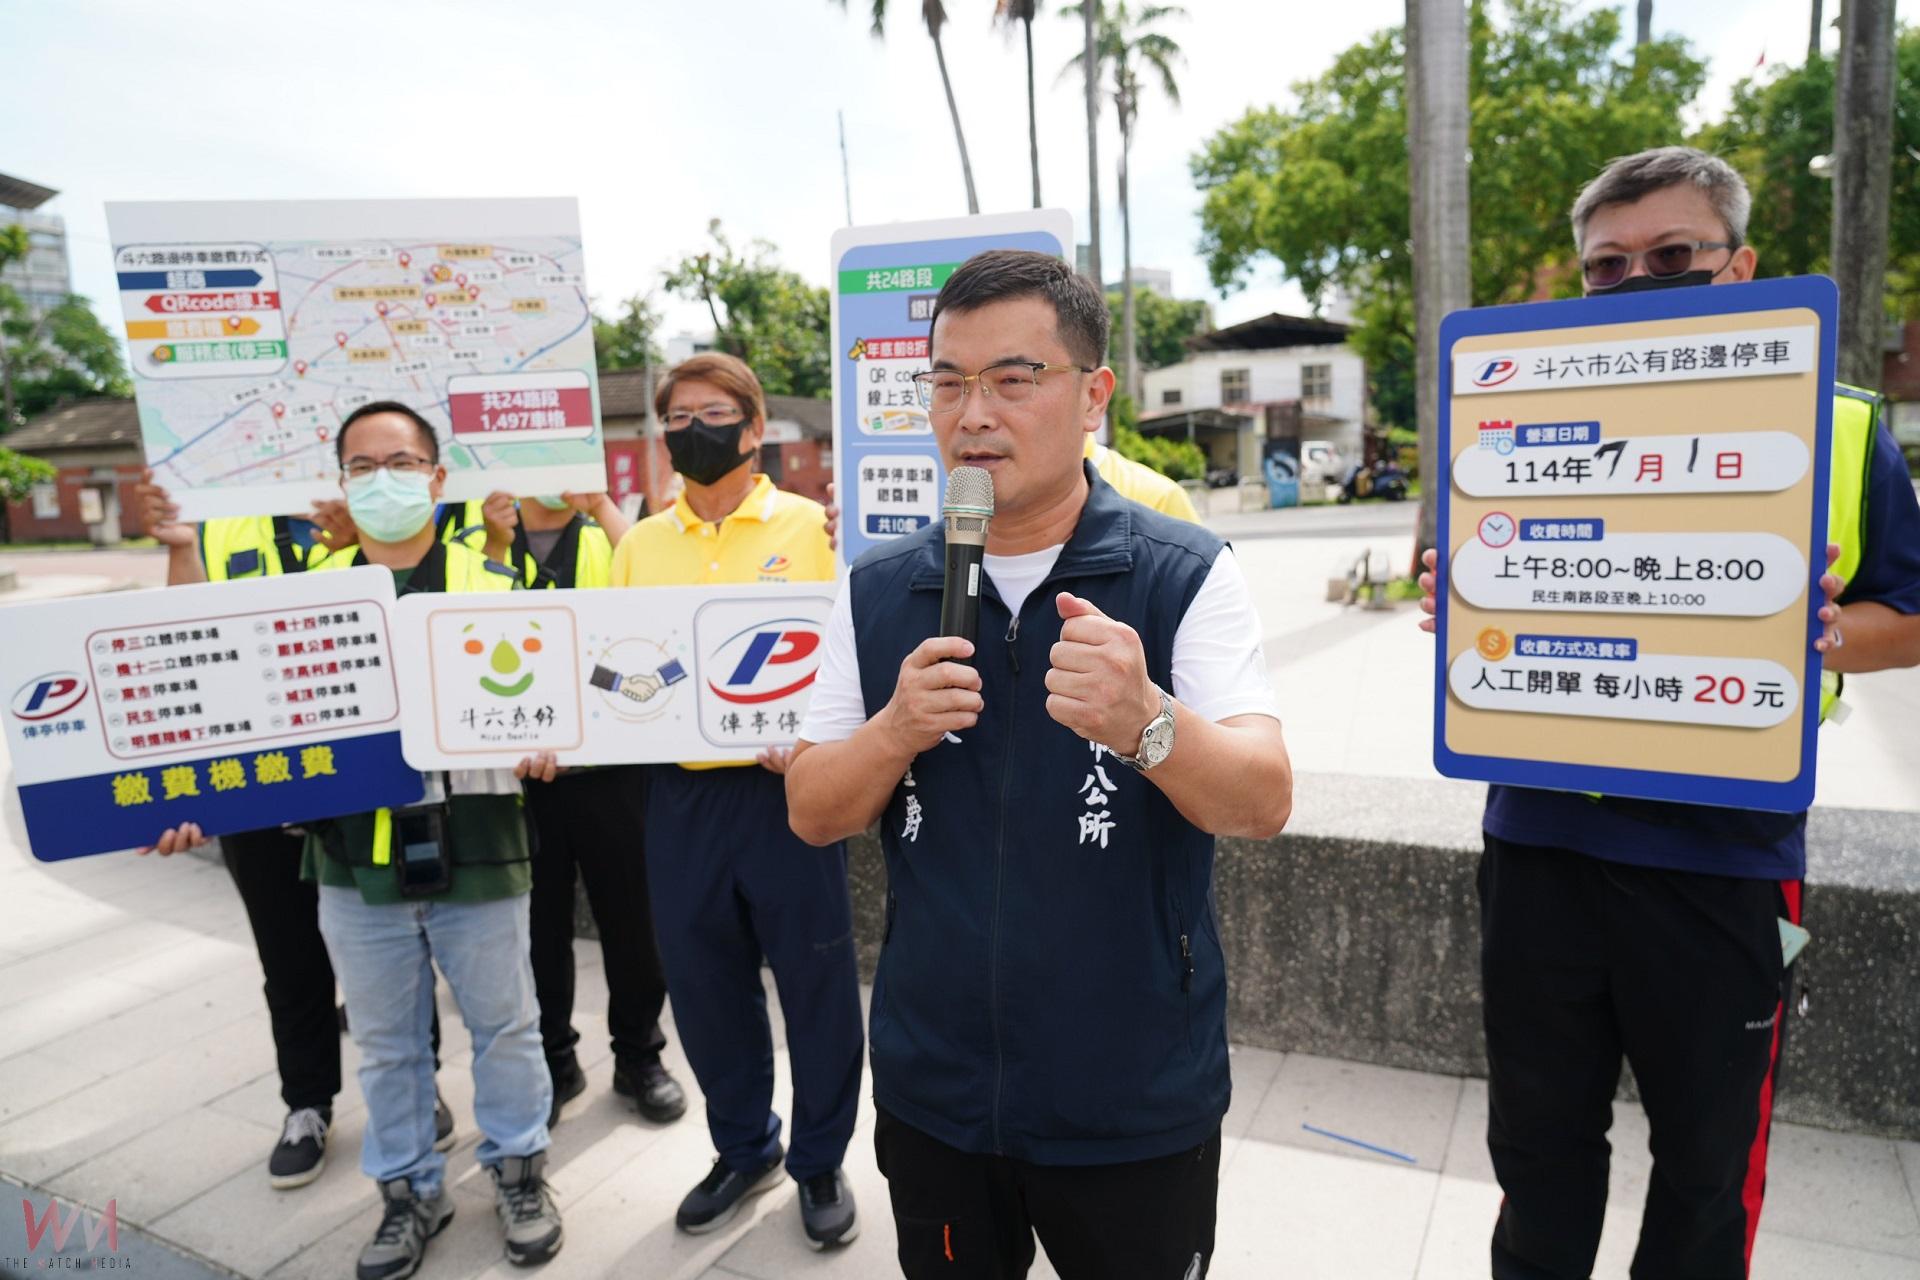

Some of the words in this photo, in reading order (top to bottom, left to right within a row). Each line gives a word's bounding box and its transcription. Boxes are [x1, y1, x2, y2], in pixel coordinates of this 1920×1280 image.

[866, 267, 932, 290] 共24路段
[910, 298, 937, 319] 繳
[1533, 340, 1791, 380] 斗六市公有路邊停車
[870, 367, 886, 383] QR
[481, 389, 560, 411] 共24路段
[868, 389, 922, 407] 線上支
[480, 410, 566, 431] 1,497車格
[1525, 425, 1590, 444] 營運日期
[1505, 456, 1593, 484] 114年
[1593, 440, 1629, 479] 7
[1635, 454, 1664, 483] 月
[1686, 437, 1700, 474] 1
[1716, 452, 1742, 480] 日
[1529, 523, 1593, 540] 收費時間
[1494, 555, 1765, 582] 上午8:00~晚上8:00
[1531, 589, 1707, 607] 民生南路段至晚上10:00
[112, 627, 219, 653] 停三立體停車場
[1520, 639, 1632, 659] 收費方式及費率
[1471, 667, 1582, 696] 人工開單
[1593, 672, 1683, 703] 每小時
[1693, 674, 1746, 705] 20
[1753, 681, 1785, 708] 元
[127, 703, 203, 725] 民生停車場
[460, 705, 558, 729] 斗六真好
[111, 745, 337, 807] 繳費機繳費
